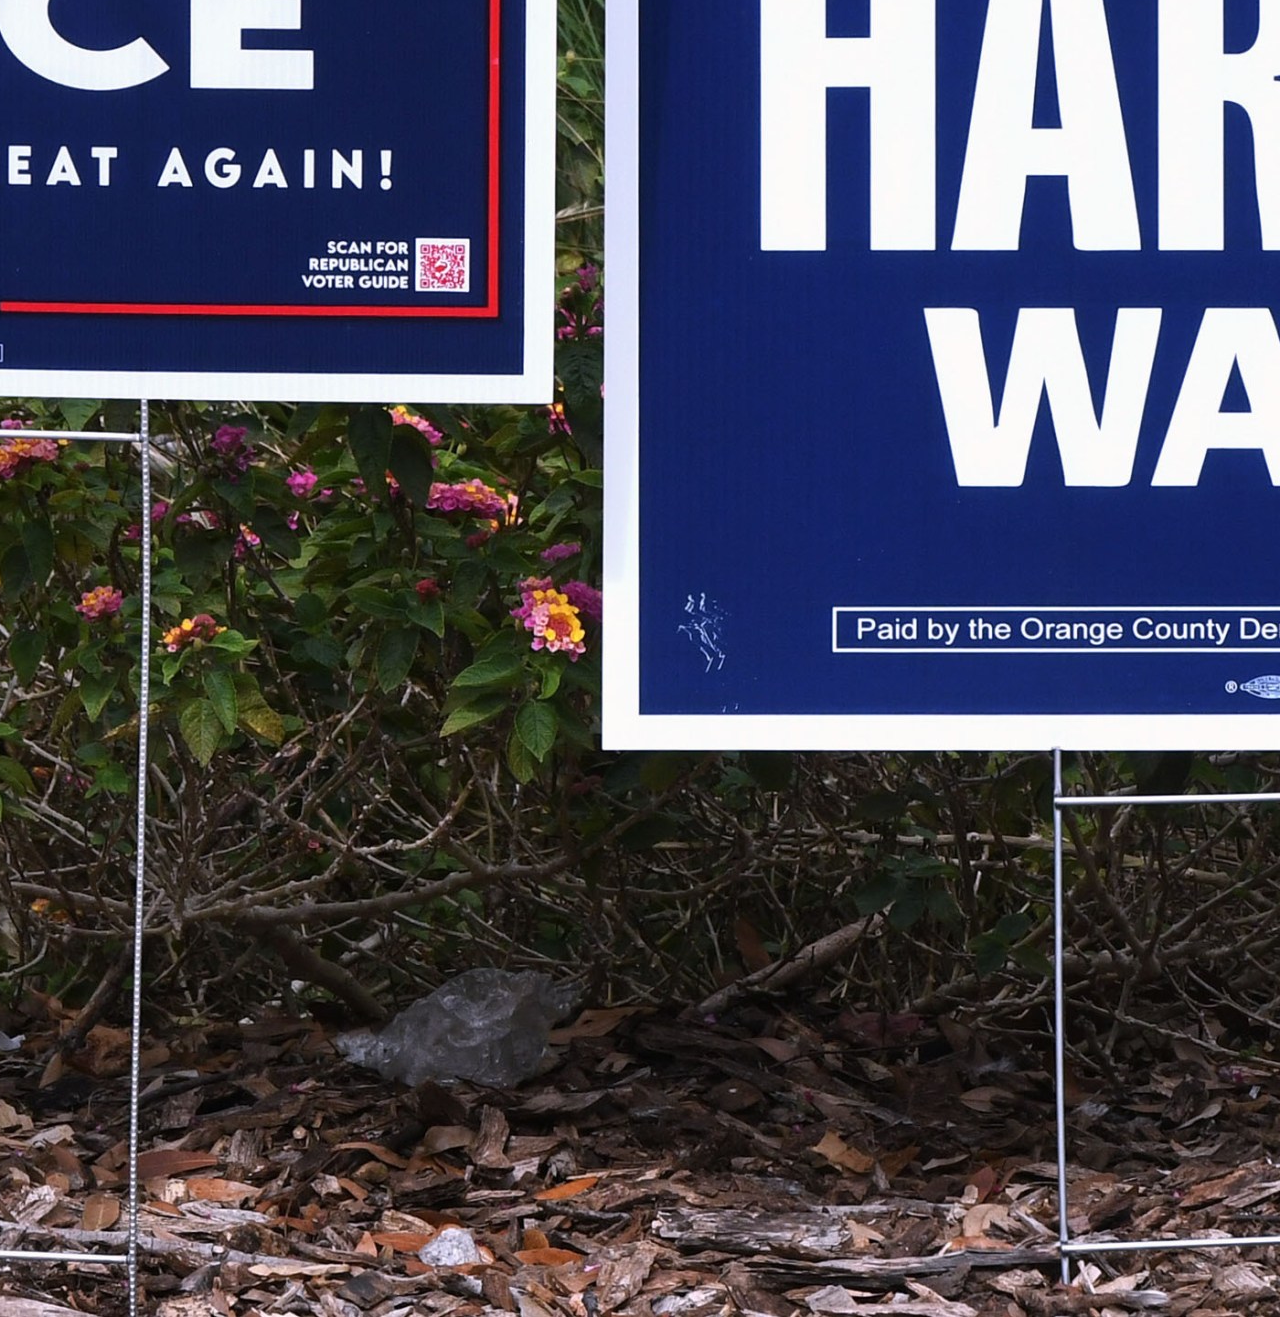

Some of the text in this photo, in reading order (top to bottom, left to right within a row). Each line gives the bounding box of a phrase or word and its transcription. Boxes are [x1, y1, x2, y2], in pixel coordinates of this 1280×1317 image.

[158, 148, 391, 190] AGAIN!
[328, 241, 408, 254] SCAN FOR
[309, 258, 408, 271] REPUBLICAN
[302, 275, 408, 288] VOTER GUIDE
[858, 618, 917, 639] Paid
[928, 618, 959, 645] by
[969, 618, 1011, 639] the
[1021, 618, 1123, 645] Orange
[1133, 618, 1230, 644] County
